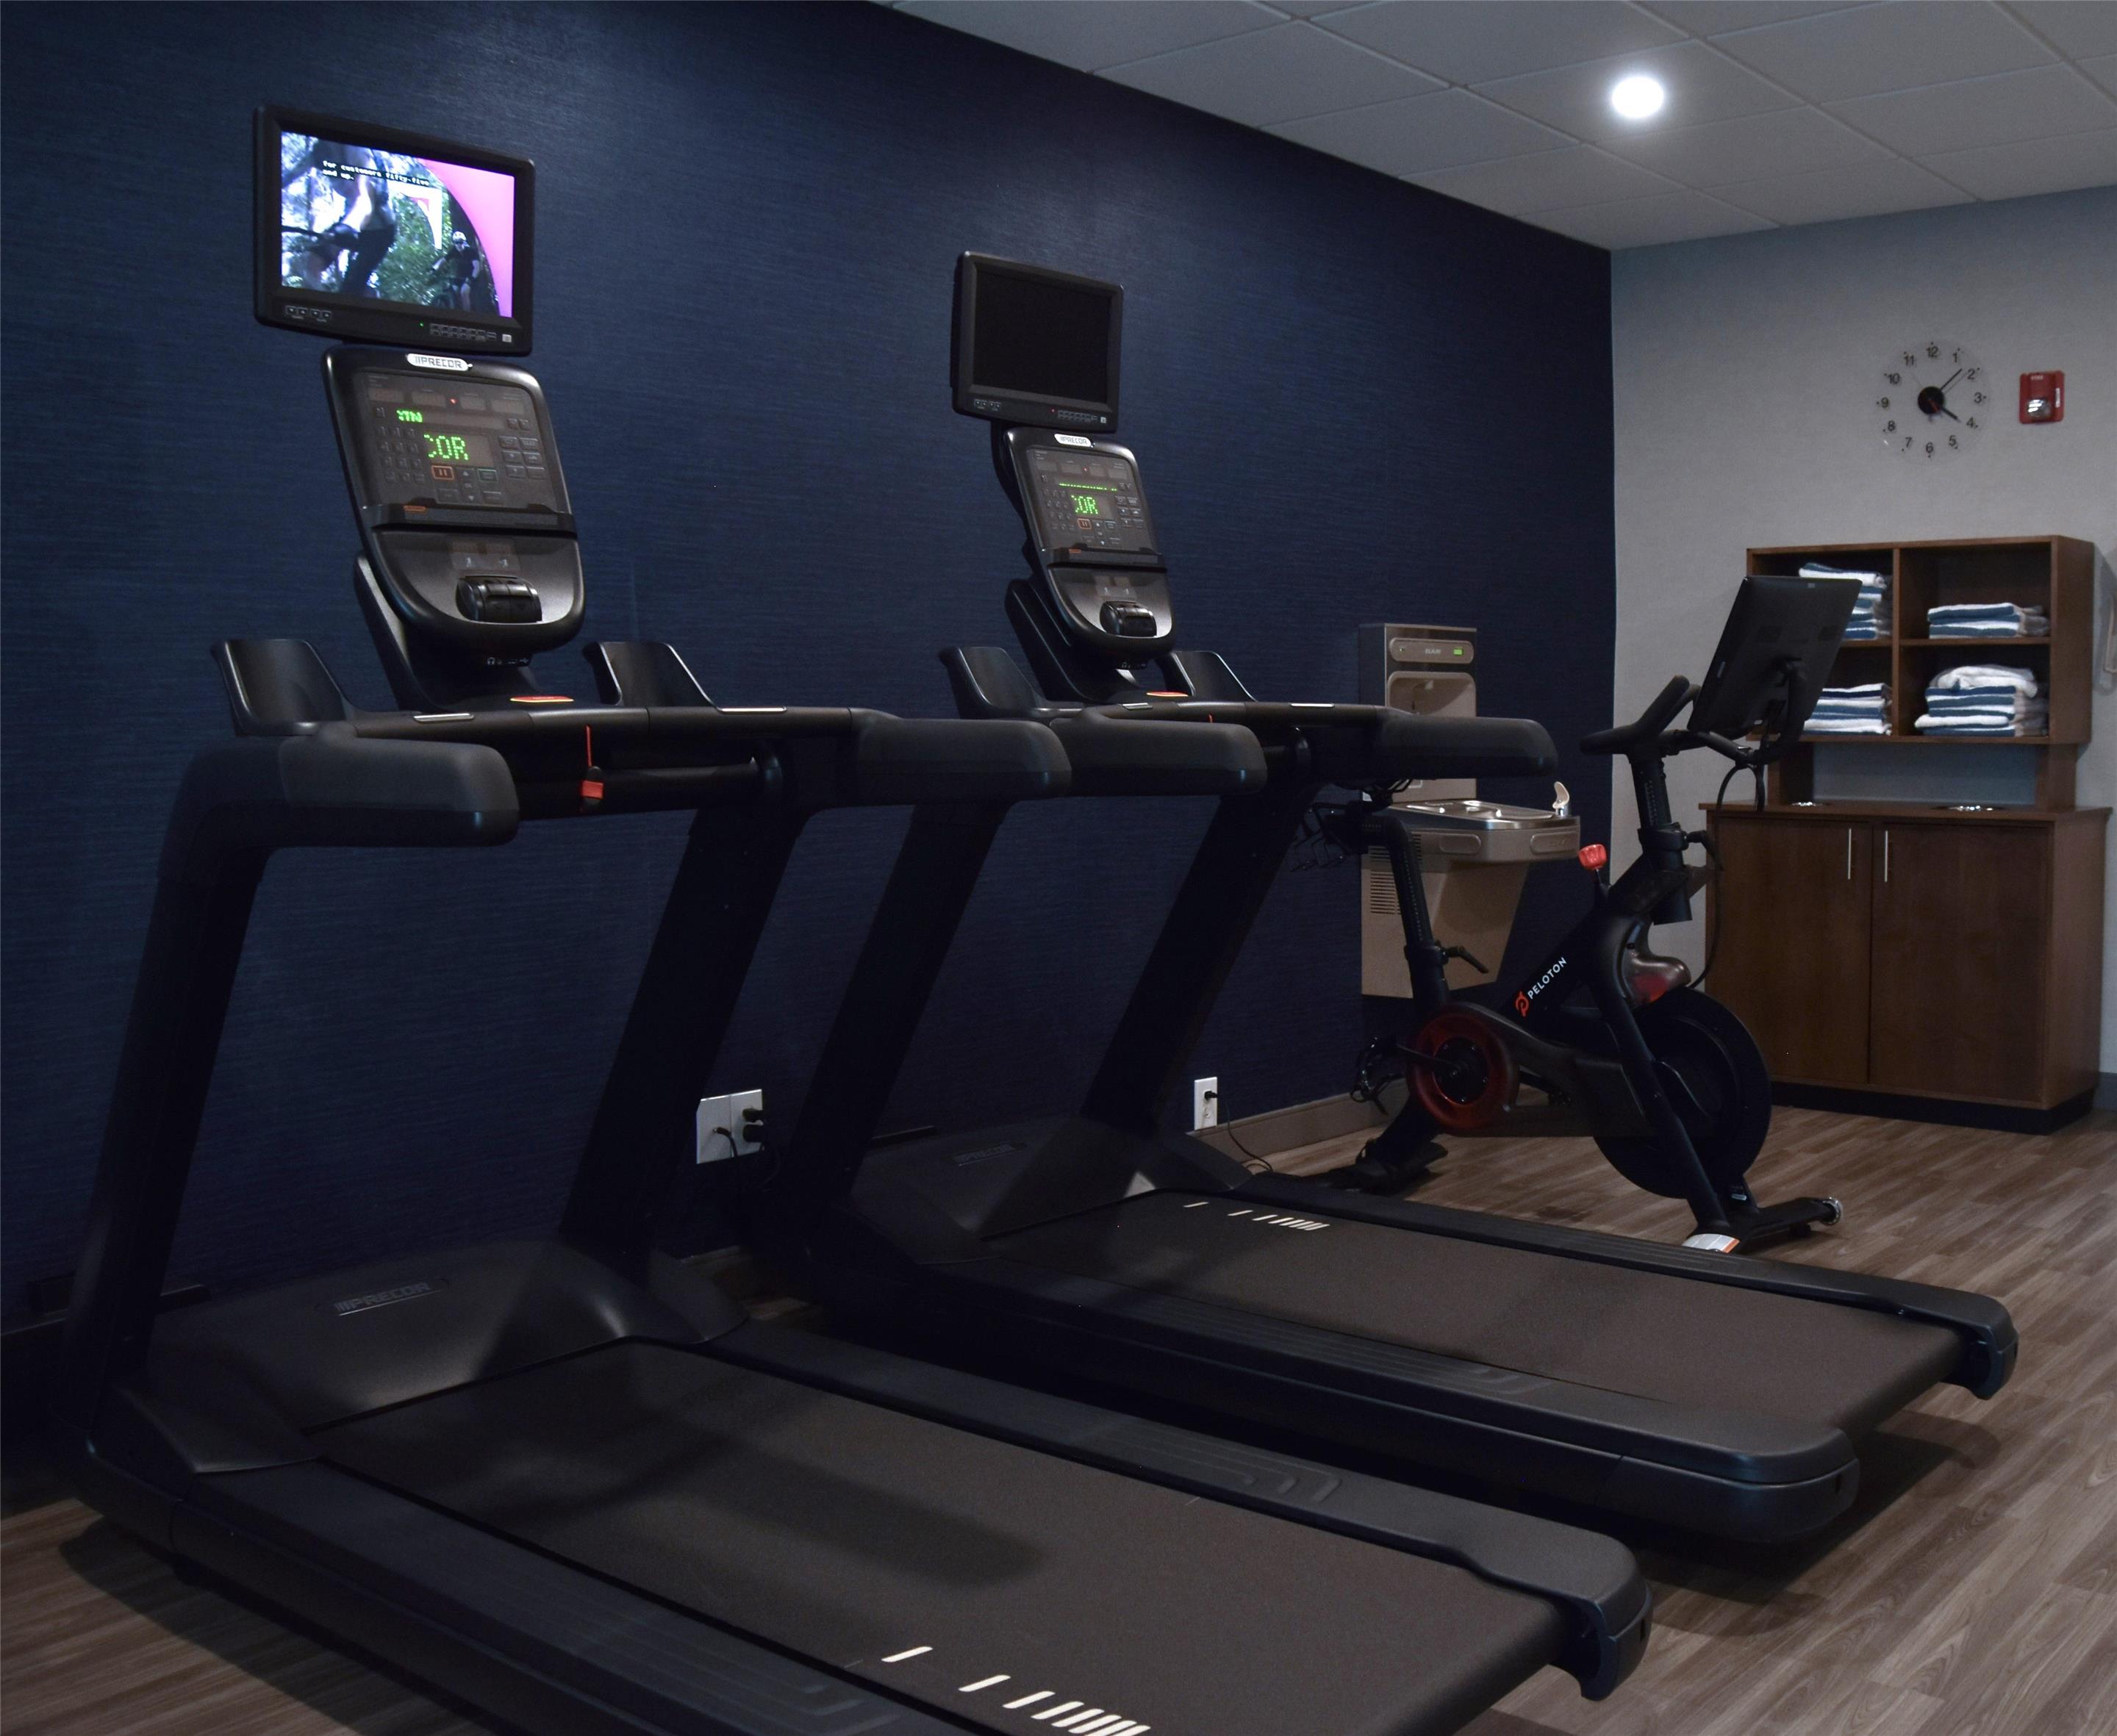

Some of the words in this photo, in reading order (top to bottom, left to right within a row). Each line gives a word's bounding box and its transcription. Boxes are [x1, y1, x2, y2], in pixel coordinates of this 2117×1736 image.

[1926, 345, 1939, 358] 12
[1952, 352, 1957, 363] 1
[420, 356, 463, 369] PRECOR
[1904, 355, 1914, 366] 11
[1888, 373, 1900, 385] 10
[1967, 368, 1975, 380] 2
[1880, 397, 1889, 408] 9
[1974, 392, 1982, 404] 3
[1888, 420, 1896, 432] 8
[1966, 417, 1974, 428] 4
[1905, 437, 1913, 448] 7
[1949, 434, 1957, 447] 5
[1925, 442, 1934, 453] 6
[1527, 956, 1567, 1000] PELOTON
